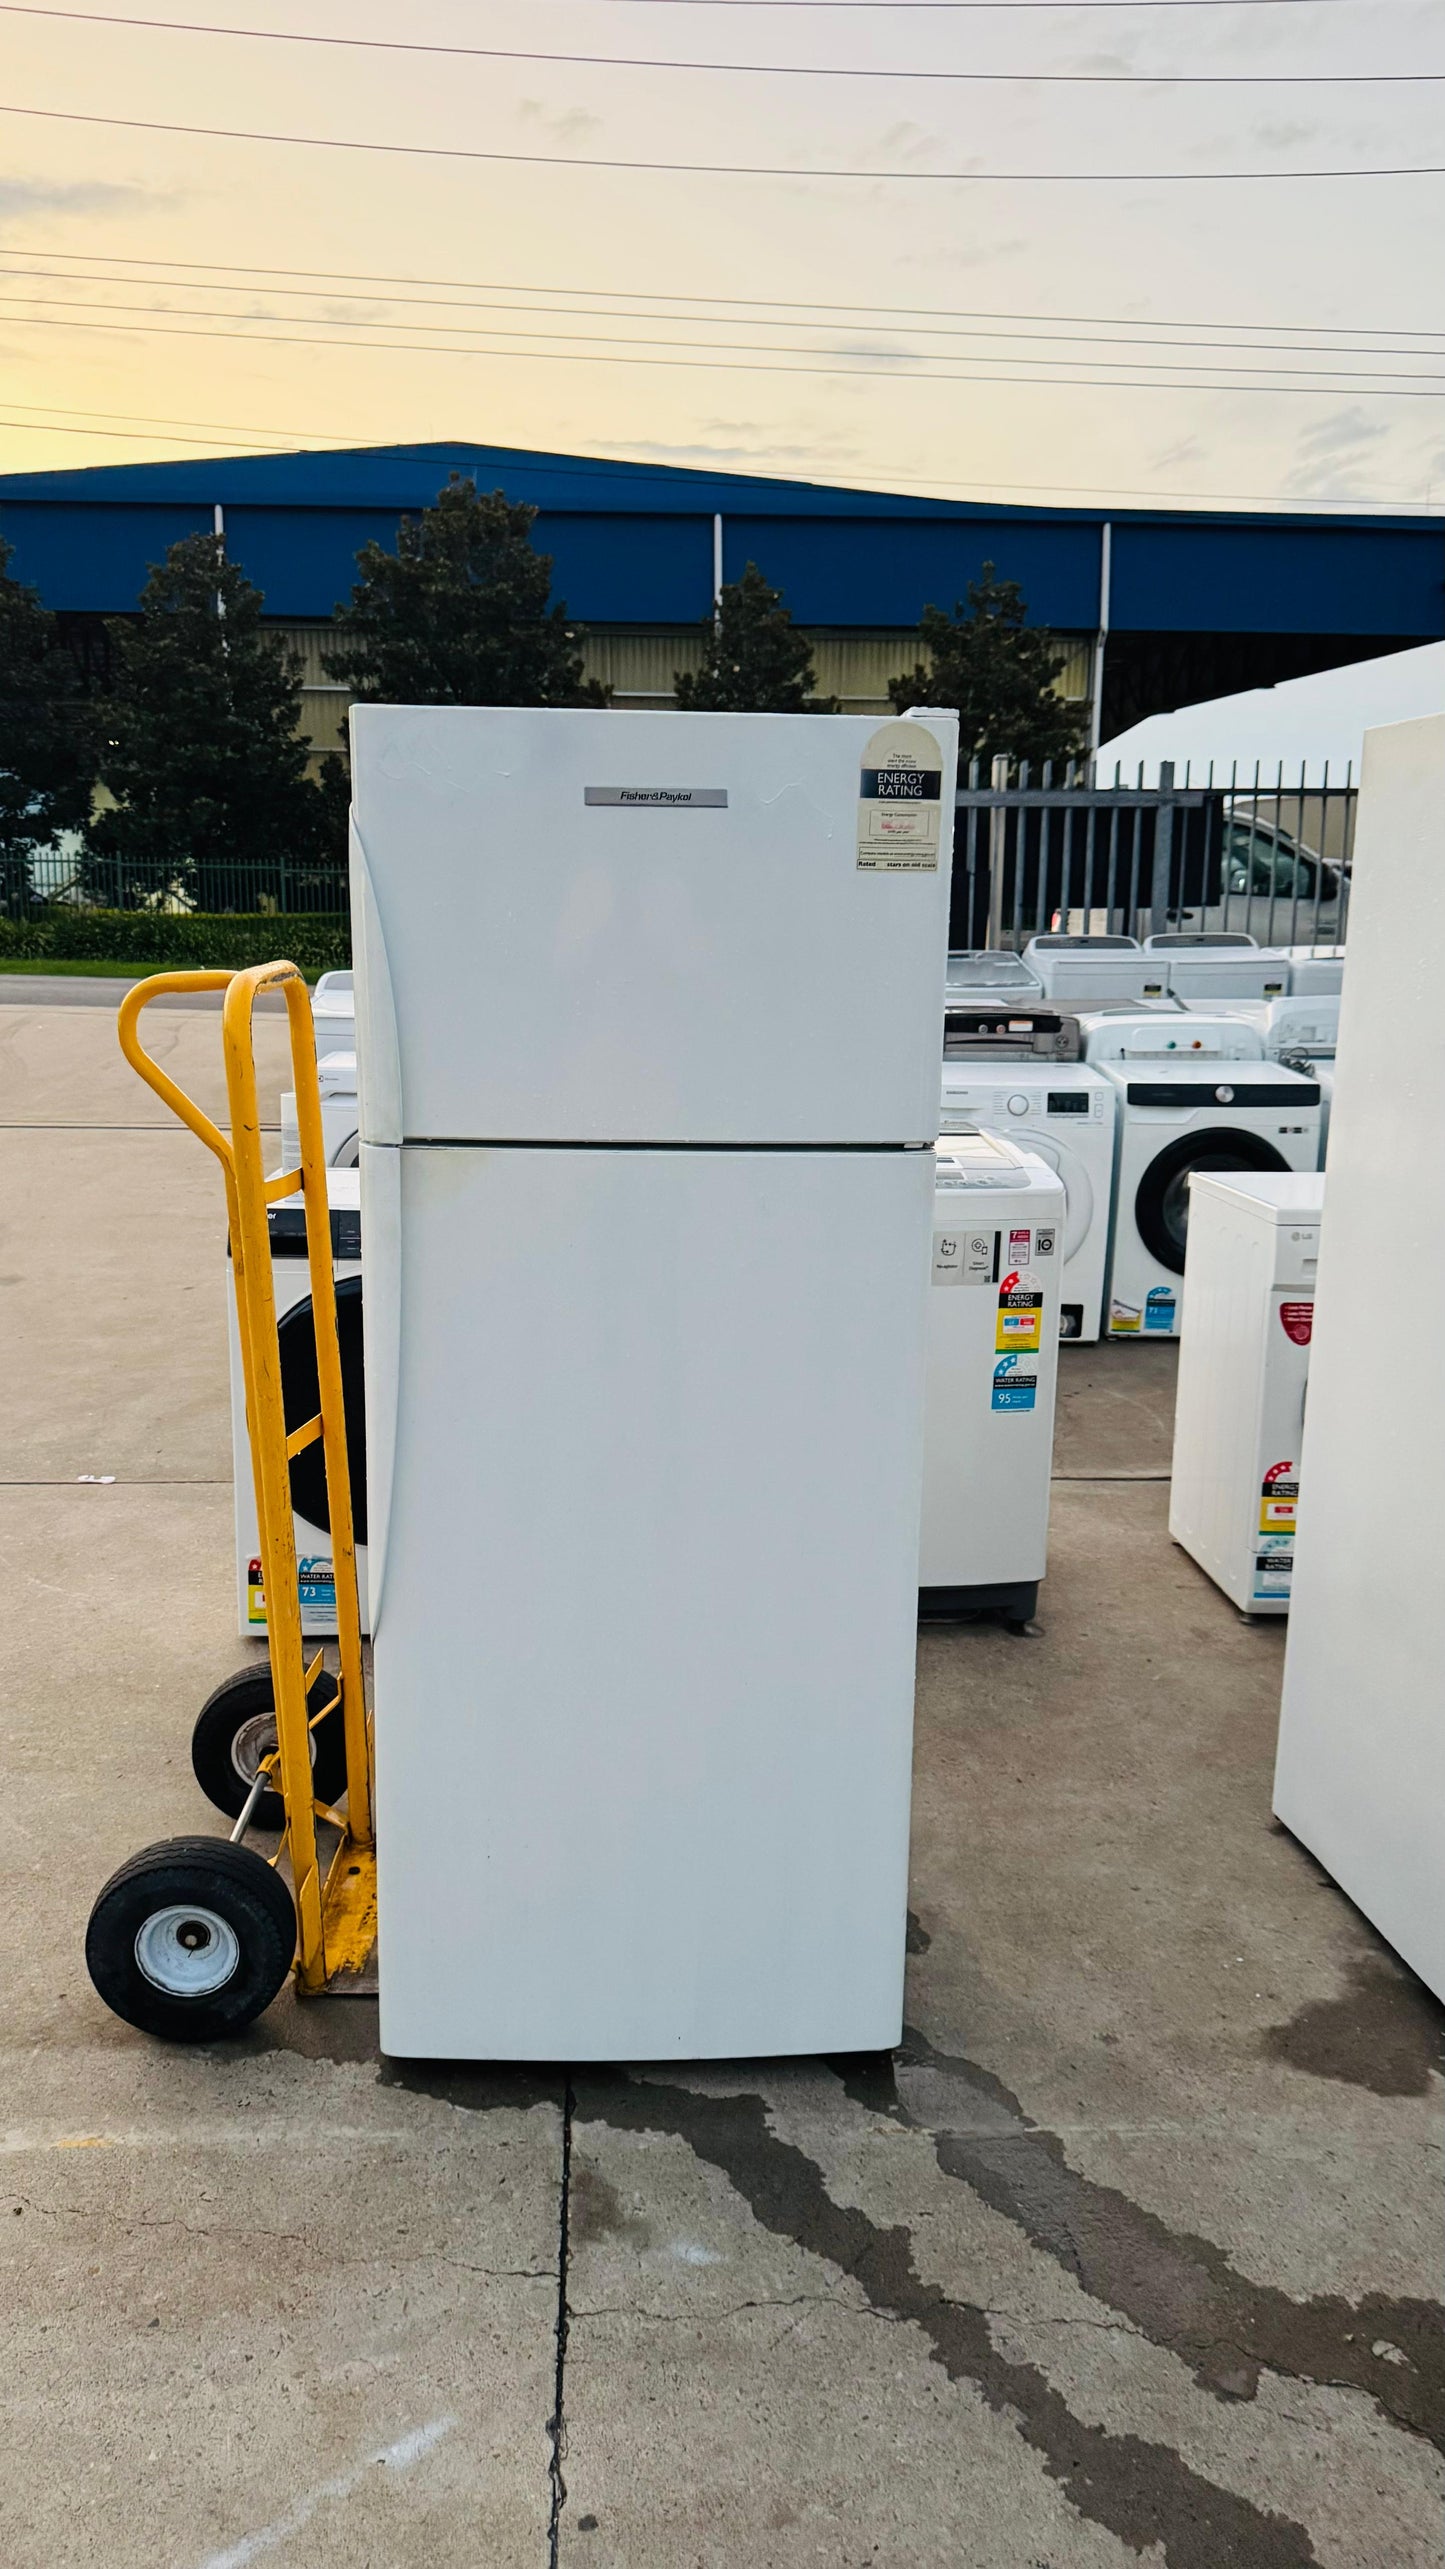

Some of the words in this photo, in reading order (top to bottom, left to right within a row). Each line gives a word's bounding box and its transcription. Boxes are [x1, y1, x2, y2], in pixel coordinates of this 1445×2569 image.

[877, 772, 925, 784] ENERGY
[878, 784, 923, 796] RATING
[998, 1393, 1011, 1404] 95
[302, 1586, 316, 1597] 73
